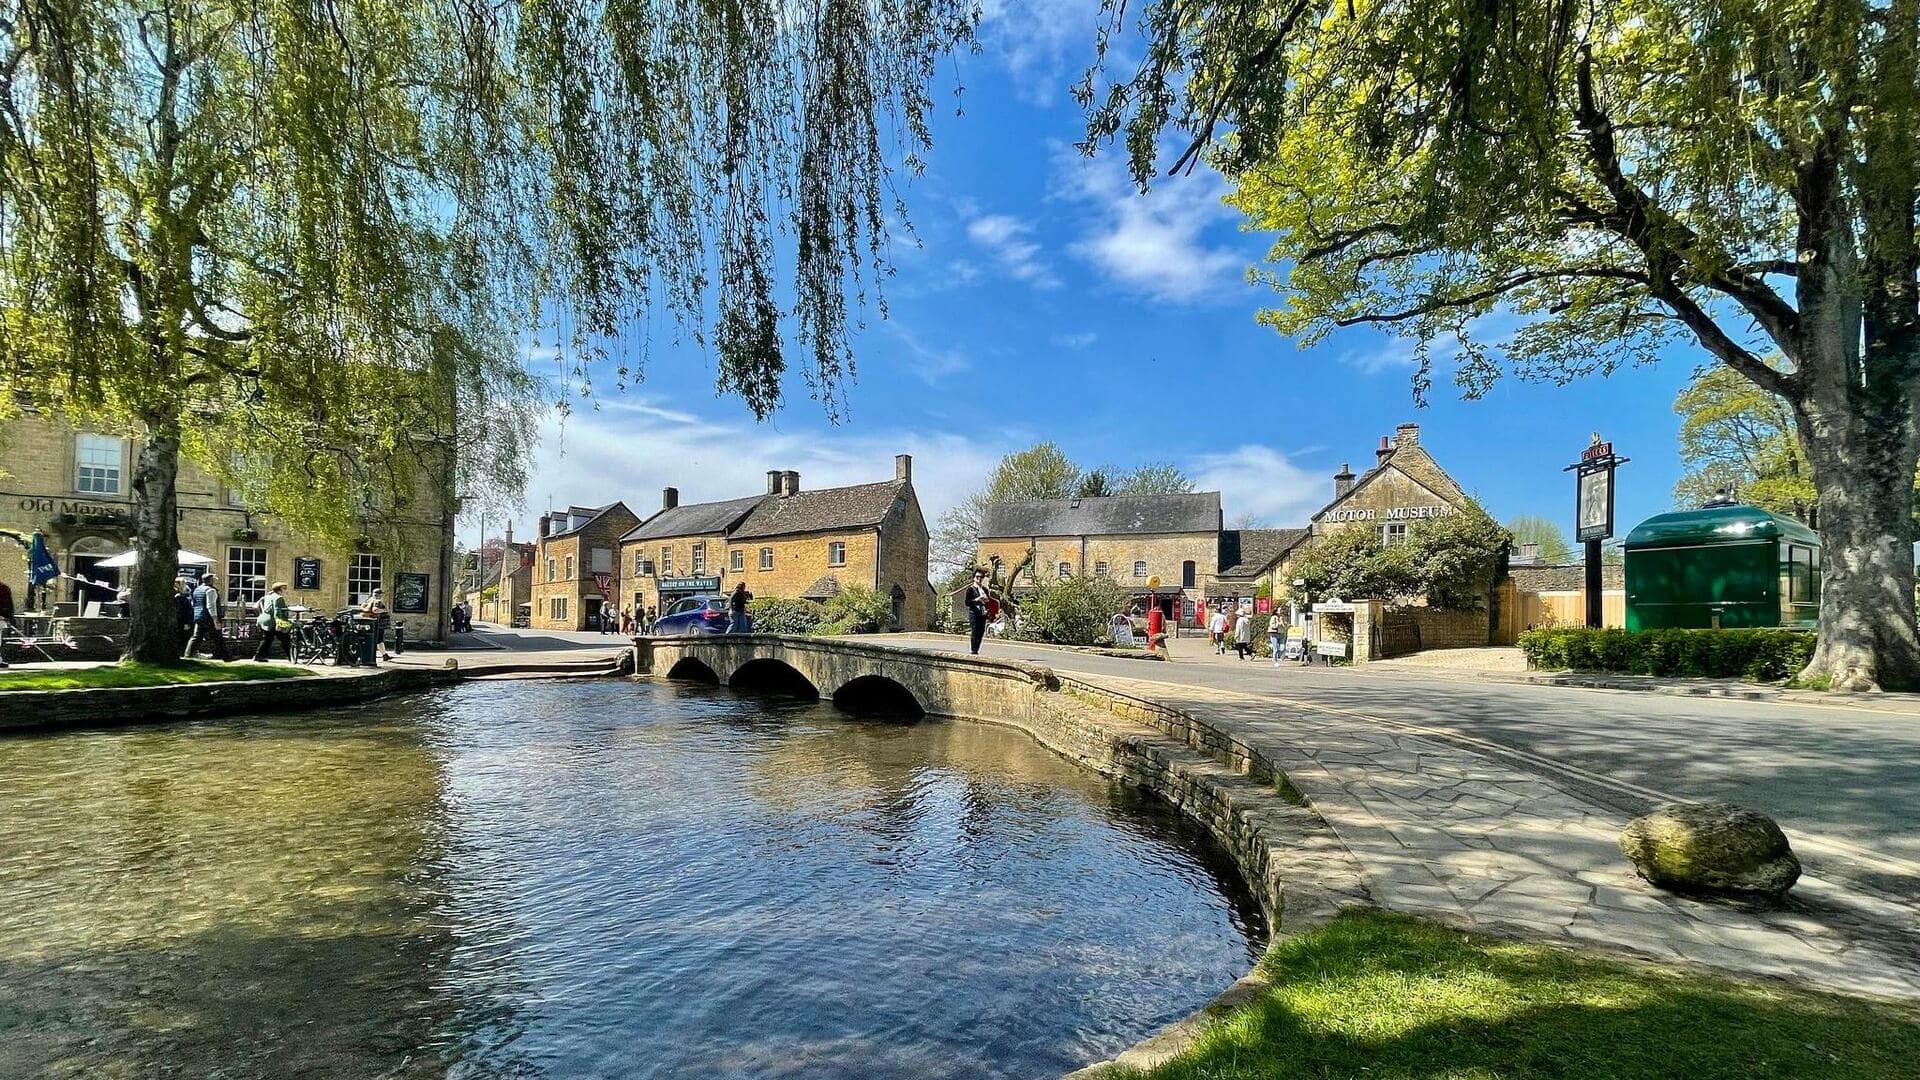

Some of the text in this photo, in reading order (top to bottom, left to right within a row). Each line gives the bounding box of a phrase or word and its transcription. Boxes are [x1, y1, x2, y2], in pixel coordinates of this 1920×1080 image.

[19, 499, 126, 515] Old Manse
[1325, 505, 1454, 522] MOTOR MUSEUM
